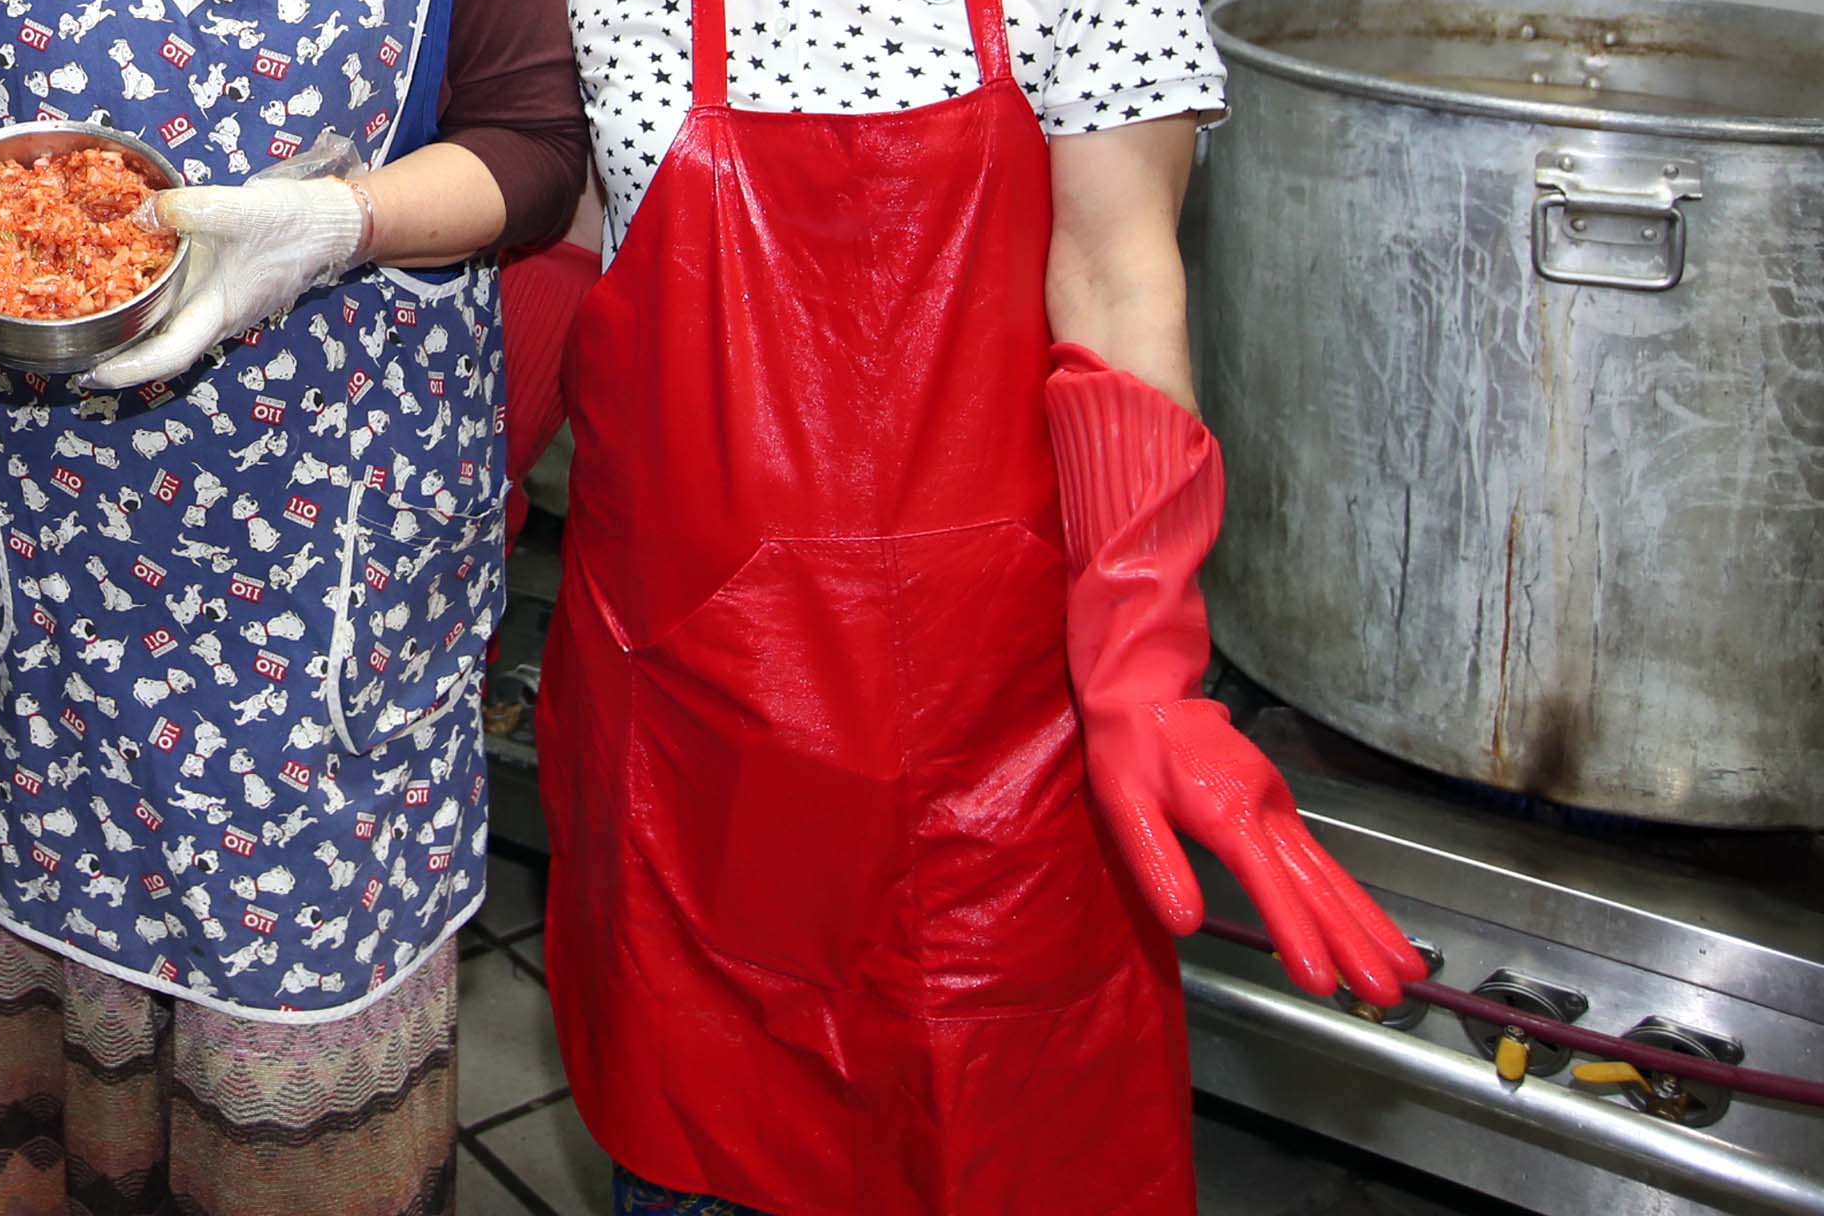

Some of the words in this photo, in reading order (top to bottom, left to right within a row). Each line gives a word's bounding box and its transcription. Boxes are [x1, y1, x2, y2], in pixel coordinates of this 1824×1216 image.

[21, 28, 47, 50] 110
[162, 45, 188, 68] 110
[380, 47, 396, 66] 110
[256, 58, 285, 77] 110
[161, 117, 188, 139] 110
[366, 113, 387, 135] 110
[270, 141, 297, 158] 110
[397, 310, 416, 324] 110
[348, 372, 366, 397] 110
[430, 380, 444, 395] 110
[254, 406, 282, 423] 110
[55, 469, 82, 488] 110
[159, 477, 179, 501] 110
[288, 498, 317, 515] 110
[10, 537, 35, 558] 110
[134, 565, 160, 586] 110
[366, 568, 387, 589] 110
[231, 585, 260, 601] 110
[34, 612, 55, 633] 110
[144, 630, 170, 650] 110
[256, 659, 284, 680] 110
[371, 650, 387, 672] 110
[64, 709, 86, 731] 110
[158, 723, 181, 749] 110
[284, 762, 310, 782] 110
[14, 772, 40, 793] 110
[406, 790, 428, 804] 110
[136, 807, 160, 830] 110
[356, 823, 373, 838] 110
[224, 836, 253, 856] 110
[33, 850, 56, 871] 110
[429, 855, 449, 869] 110
[144, 875, 165, 891] 110
[244, 915, 274, 933] 110
